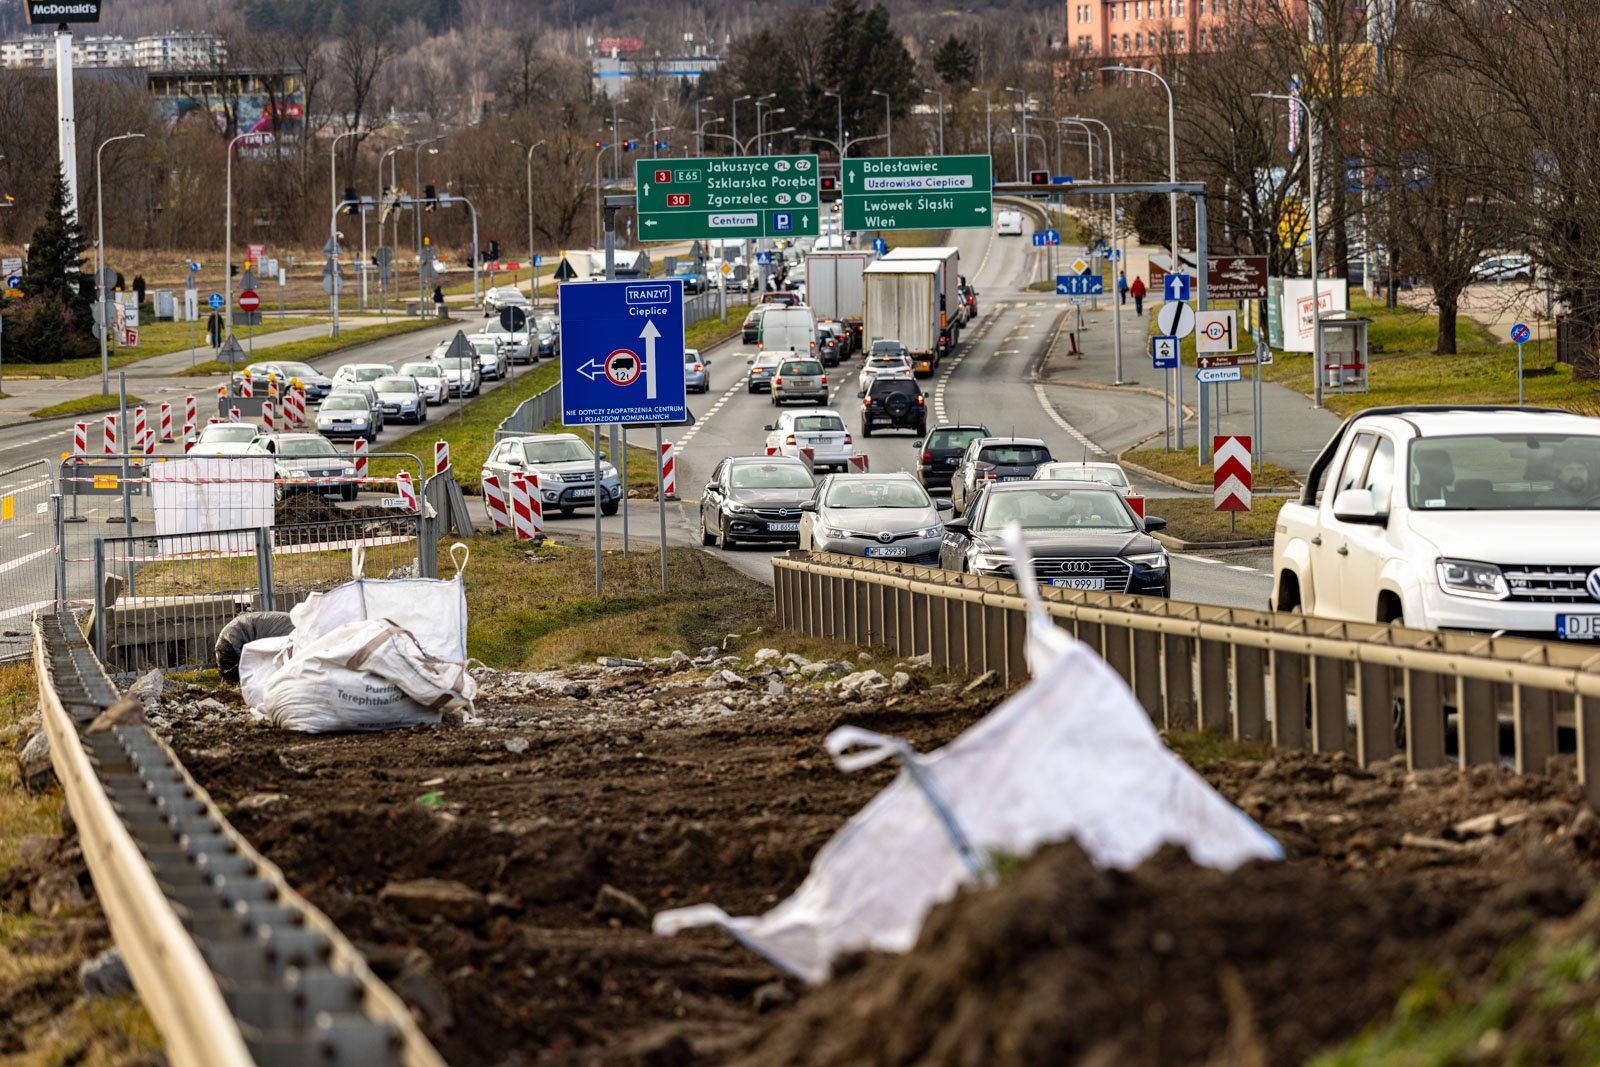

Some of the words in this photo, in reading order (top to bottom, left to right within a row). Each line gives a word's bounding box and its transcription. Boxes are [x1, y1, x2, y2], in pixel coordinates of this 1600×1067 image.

[33, 3, 97, 15] McDonald's
[706, 161, 770, 175] Jakuszyce
[777, 162, 788, 170] PL
[796, 161, 808, 169] CZ
[863, 160, 939, 173] Bolesławiec
[659, 172, 666, 182] 3
[678, 171, 698, 181] E65
[707, 177, 767, 189] Szklarska
[771, 175, 817, 189] Poręba
[868, 179, 922, 189] Uzdrowisko
[925, 178, 966, 189] Cieplice
[672, 195, 685, 205] 30
[707, 193, 769, 208] Zgorzelec
[864, 199, 913, 212] Lwówek
[917, 195, 954, 213] Śląski
[712, 216, 754, 226] Centrum
[864, 215, 896, 227] Wleń
[1207, 283, 1228, 292] Ogród
[1228, 283, 1258, 291] Japoński
[628, 289, 669, 300] TRANZYT
[1303, 298, 1327, 314] WONA
[628, 306, 668, 318] Cieplice
[615, 371, 629, 381] 12t
[1203, 371, 1239, 380] Centrum
[578, 408, 606, 416] DOTYCZY
[606, 406, 653, 415] ZAOPATRZENIA
[654, 405, 684, 413] CENTRUM
[621, 413, 670, 421] KOMUNALNYCH
[869, 547, 883, 556] WPL
[884, 546, 906, 556] 29935
[1510, 579, 1527, 587] V6
